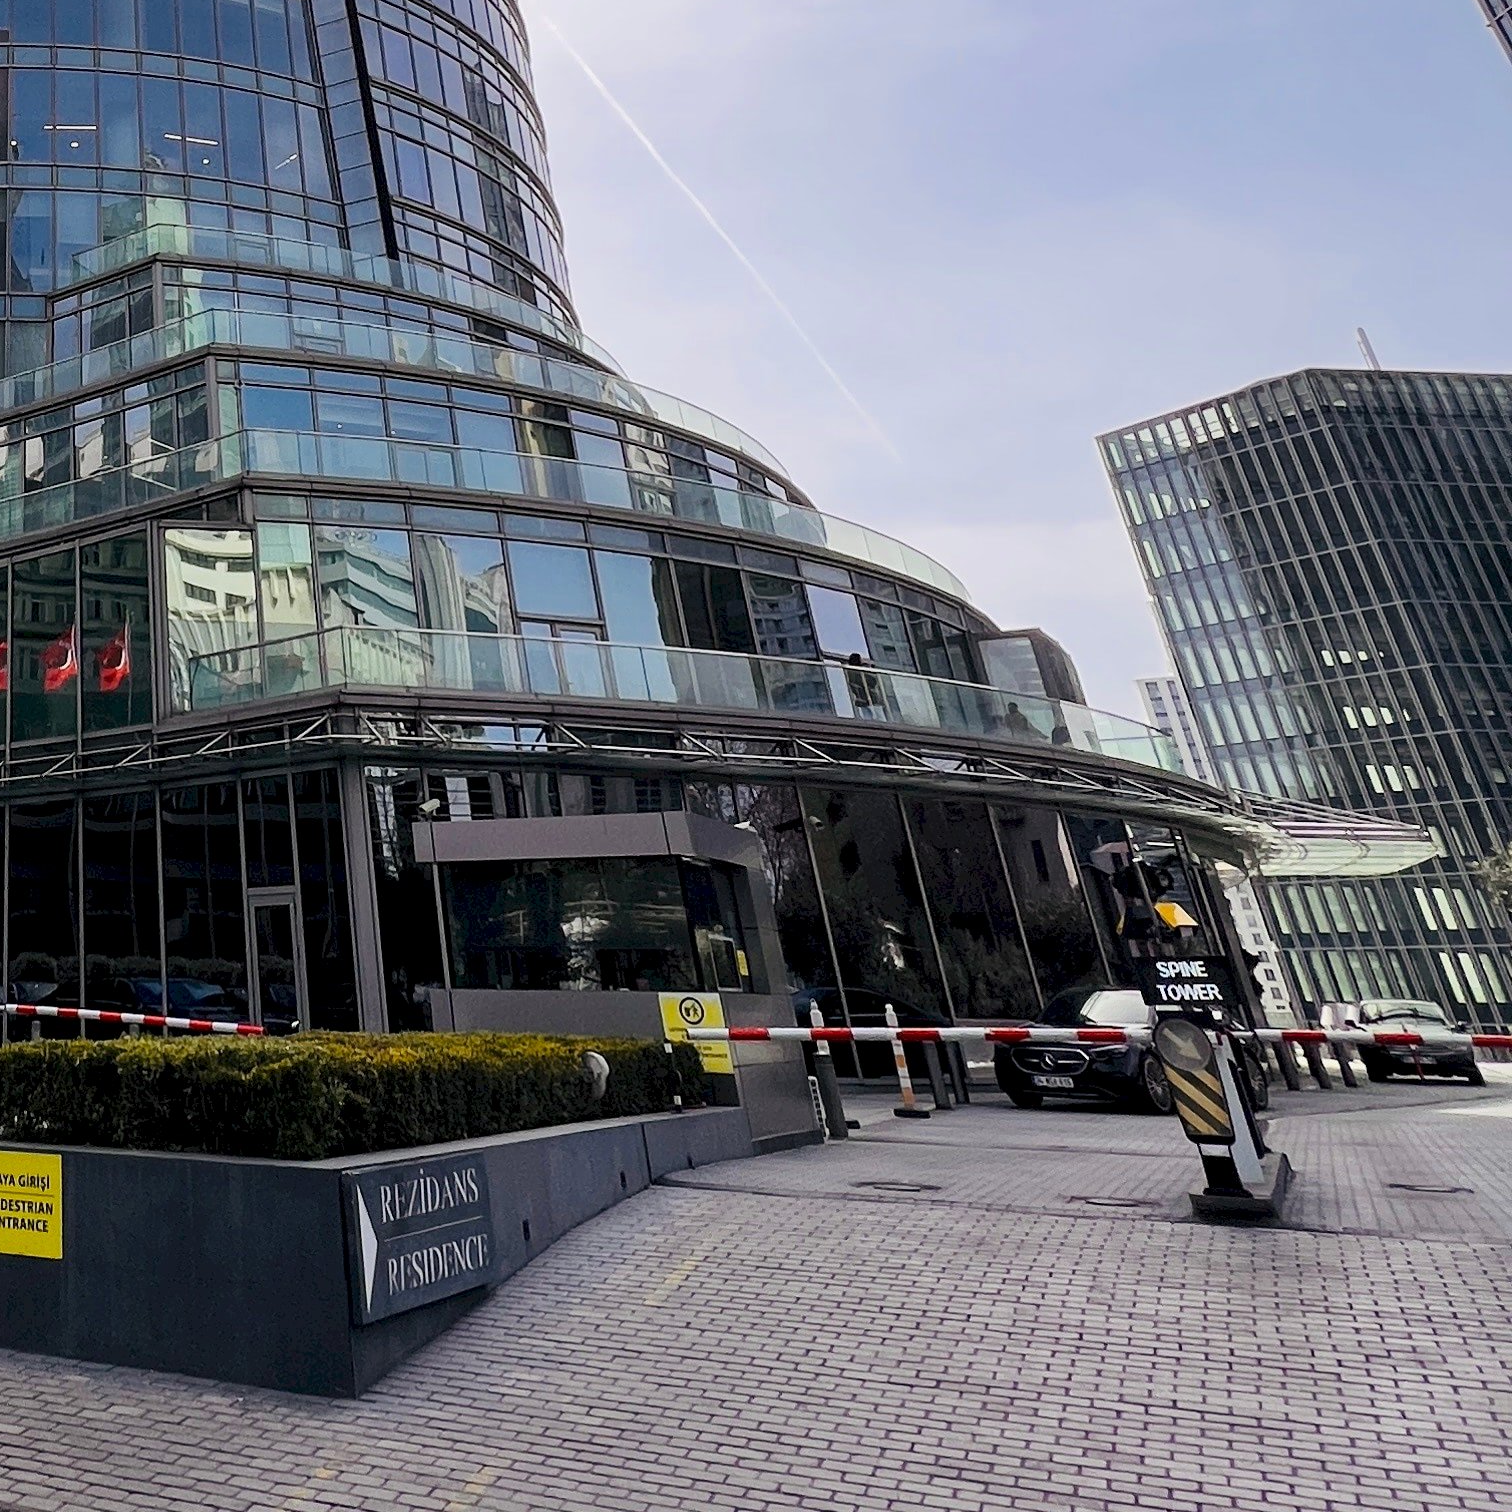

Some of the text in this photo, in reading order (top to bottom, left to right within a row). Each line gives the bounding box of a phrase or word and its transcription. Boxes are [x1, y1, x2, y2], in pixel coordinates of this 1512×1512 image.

[1155, 960, 1209, 978] SPINE
[1155, 983, 1224, 1001] TOWER
[18, 1173, 50, 1192] GİRİŞİ
[380, 1167, 479, 1225] REZİDANS
[388, 1233, 490, 1296] RESIDENCE
